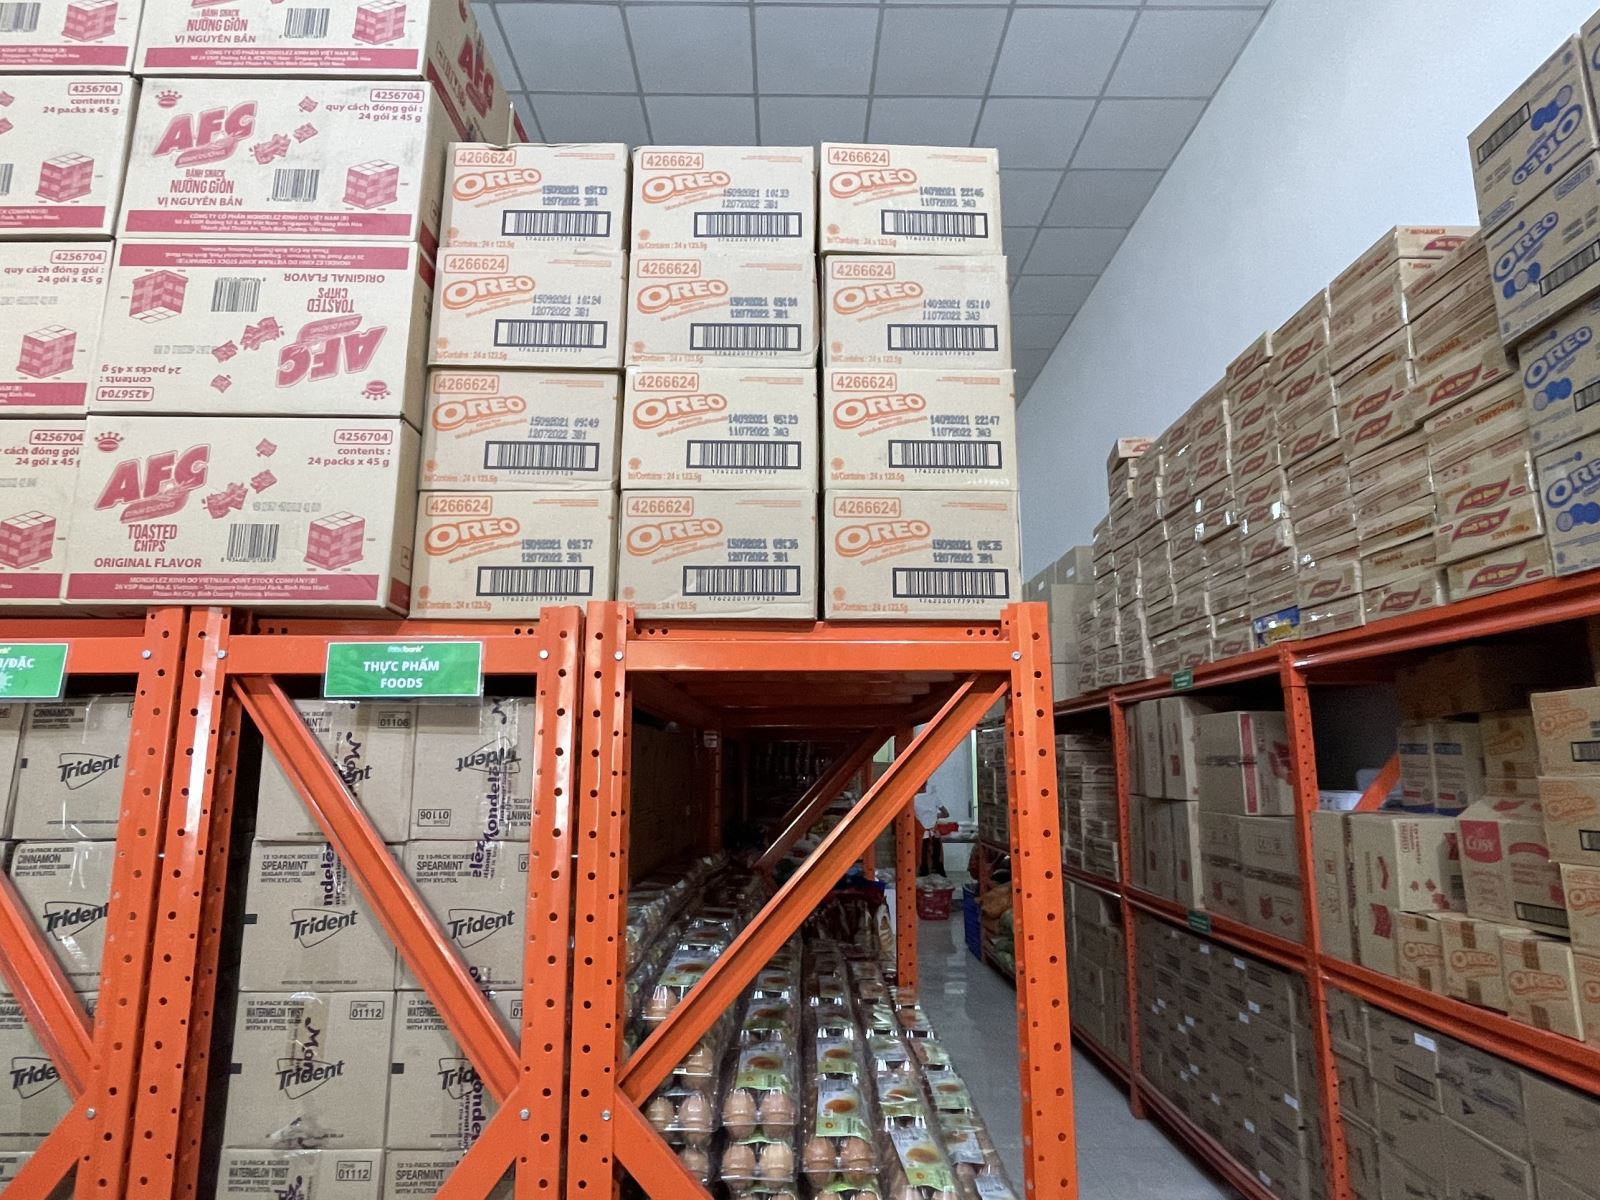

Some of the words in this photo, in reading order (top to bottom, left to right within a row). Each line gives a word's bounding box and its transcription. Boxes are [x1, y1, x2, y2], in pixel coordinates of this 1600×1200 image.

[72, 85, 118, 93] 4256704
[374, 92, 420, 100] 4256704
[57, 107, 87, 115] packs
[326, 105, 345, 113] quy
[347, 103, 370, 111] cách
[372, 104, 398, 113] đóng
[401, 104, 417, 113] gói
[374, 113, 390, 122] gói
[151, 100, 258, 157] AFC
[1512, 103, 1583, 185] OREO
[459, 152, 513, 164] 4266624
[646, 155, 700, 167] 4266624
[833, 151, 887, 163] 4266624
[453, 169, 542, 200] OREO
[642, 171, 730, 203] OREO
[829, 168, 917, 199] OREO
[157, 197, 169, 207] VỊ
[171, 195, 217, 206] NGUYÊN
[1494, 211, 1559, 283] OREO
[55, 253, 102, 261] 4256704
[450, 258, 506, 270] 4266624
[642, 263, 697, 275] 4266624
[4, 267, 24, 275] quy
[52, 266, 79, 275] đóng
[82, 266, 99, 275] gói
[837, 265, 892, 276] 4266624
[53, 276, 70, 285] gói
[283, 273, 327, 283] FLAVOR
[330, 273, 385, 283] ORIGINAL
[318, 287, 348, 299] CHIPS
[443, 275, 535, 310] OREO
[637, 280, 728, 314] OREO
[833, 281, 923, 315] OREO
[307, 298, 355, 313] TOASTED
[275, 325, 388, 388] AFC
[1524, 326, 1592, 389] OREO
[135, 365, 166, 374] packs
[439, 378, 496, 391] 4266624
[639, 376, 696, 388] 4266624
[836, 376, 894, 388] 4266624
[101, 389, 149, 398] 4256704
[432, 396, 527, 431] OREO
[633, 393, 727, 429] OREO
[833, 393, 926, 429] OREO
[34, 433, 83, 441] 4256704
[338, 432, 388, 441] 4256704
[4, 446, 28, 455] cách
[31, 447, 59, 457] đóng
[62, 447, 79, 457] gói
[32, 458, 49, 467] gói
[308, 457, 321, 465] 24
[324, 457, 355, 467] packs
[366, 457, 379, 465] 45
[382, 459, 390, 467] g
[94, 443, 212, 511] AFC
[431, 499, 489, 512] 4266624
[632, 501, 690, 513] 4266624
[839, 501, 897, 514] 4266624
[128, 524, 177, 540] TOASTED
[424, 517, 520, 556] OREO
[627, 518, 723, 556] OREO
[835, 520, 931, 557] OREO
[134, 540, 166, 552] CHIPS
[94, 557, 151, 568] ORIGINAL
[154, 558, 202, 568] FLAVOR
[363, 660, 399, 674] THỰC
[401, 658, 440, 671] PHẨM
[380, 678, 423, 688] FOODS
[380, 718, 409, 727] 01106
[455, 746, 521, 771] Trident
[57, 754, 121, 782] Trident
[420, 811, 449, 820] 01106
[17, 855, 61, 864] CINNAMON
[261, 861, 308, 870] SPEARMINT
[417, 861, 463, 870] SPEARMINT
[43, 902, 110, 932] Trident
[290, 910, 358, 939] Trident
[447, 910, 515, 939] Trident
[351, 1009, 382, 1018] 01112
[10, 1064, 60, 1089] Tride
[275, 1060, 345, 1090] Trident
[338, 1170, 369, 1179] 01112
[396, 1170, 444, 1180] SPEARMINT
